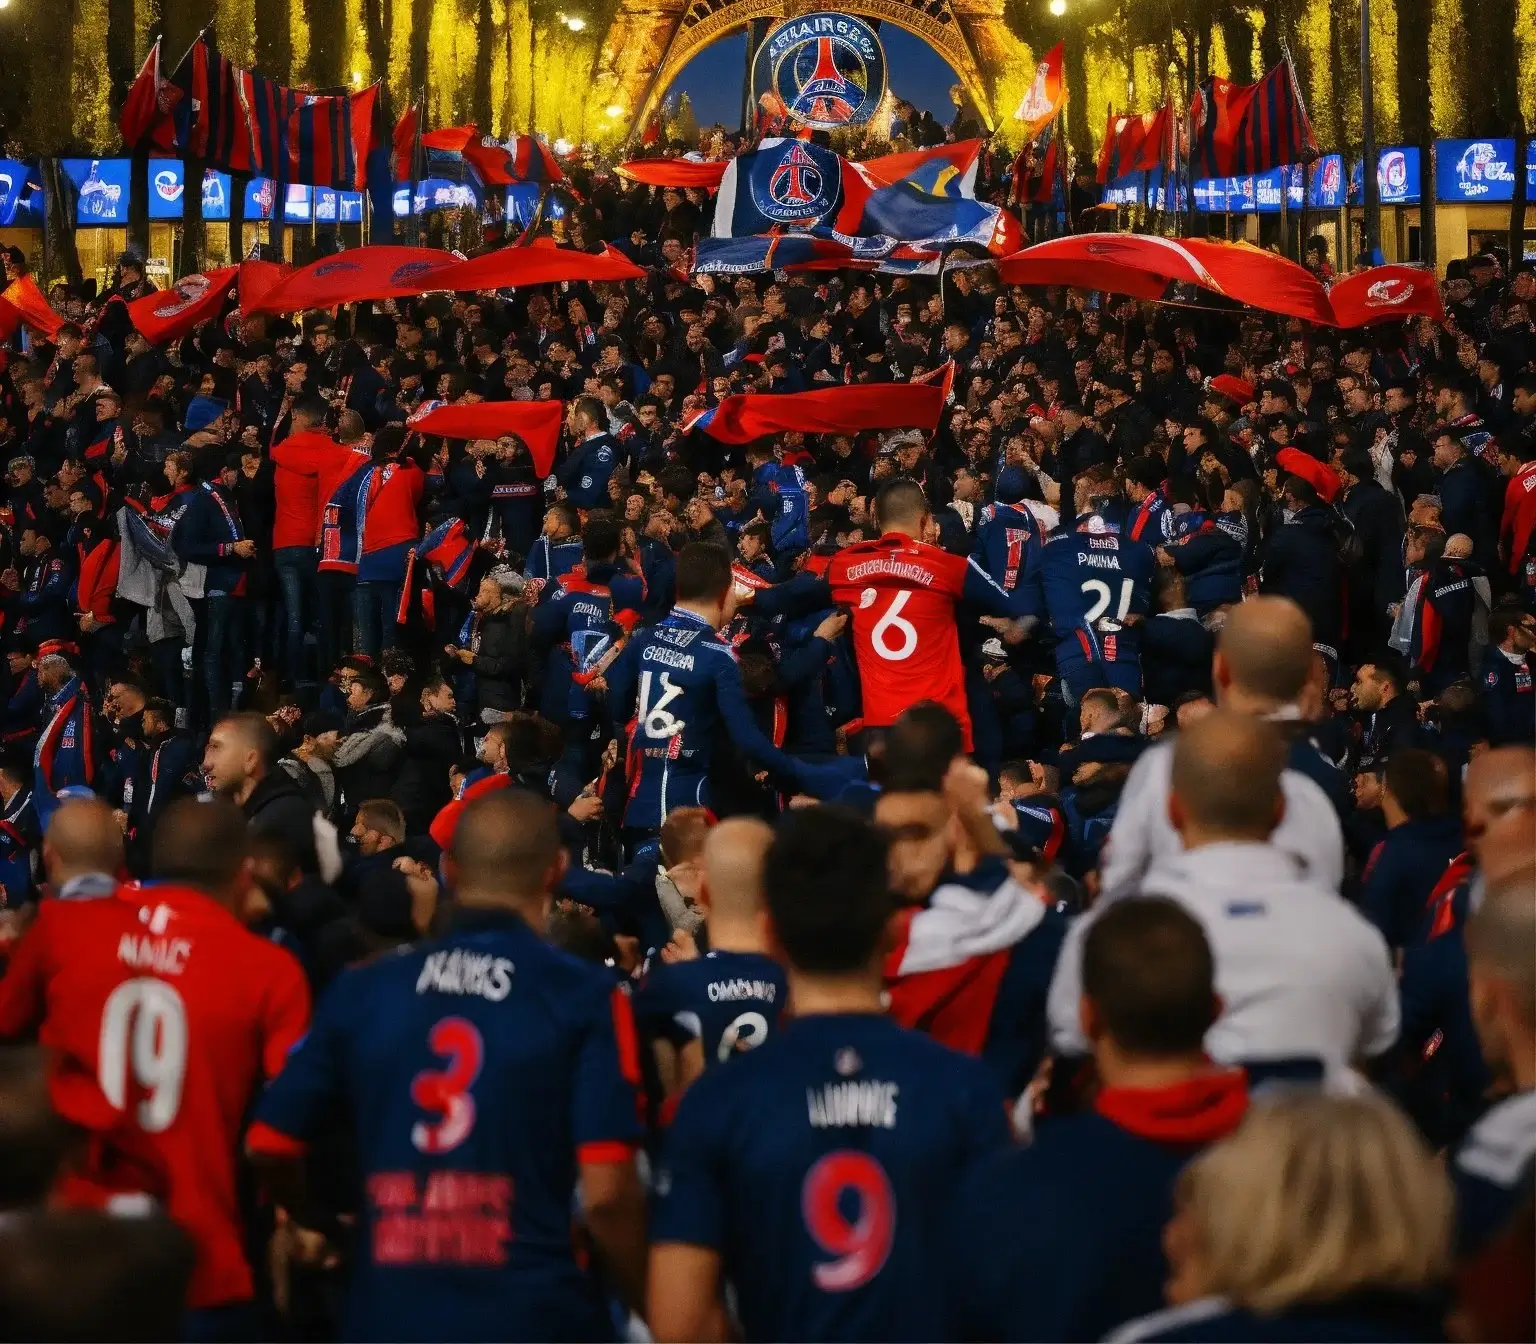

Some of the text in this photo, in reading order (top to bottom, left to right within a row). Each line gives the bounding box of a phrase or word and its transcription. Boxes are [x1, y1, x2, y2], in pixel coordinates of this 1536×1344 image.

[871, 589, 918, 661] 6
[410, 1016, 485, 1154] 3
[802, 1148, 896, 1292] 9
